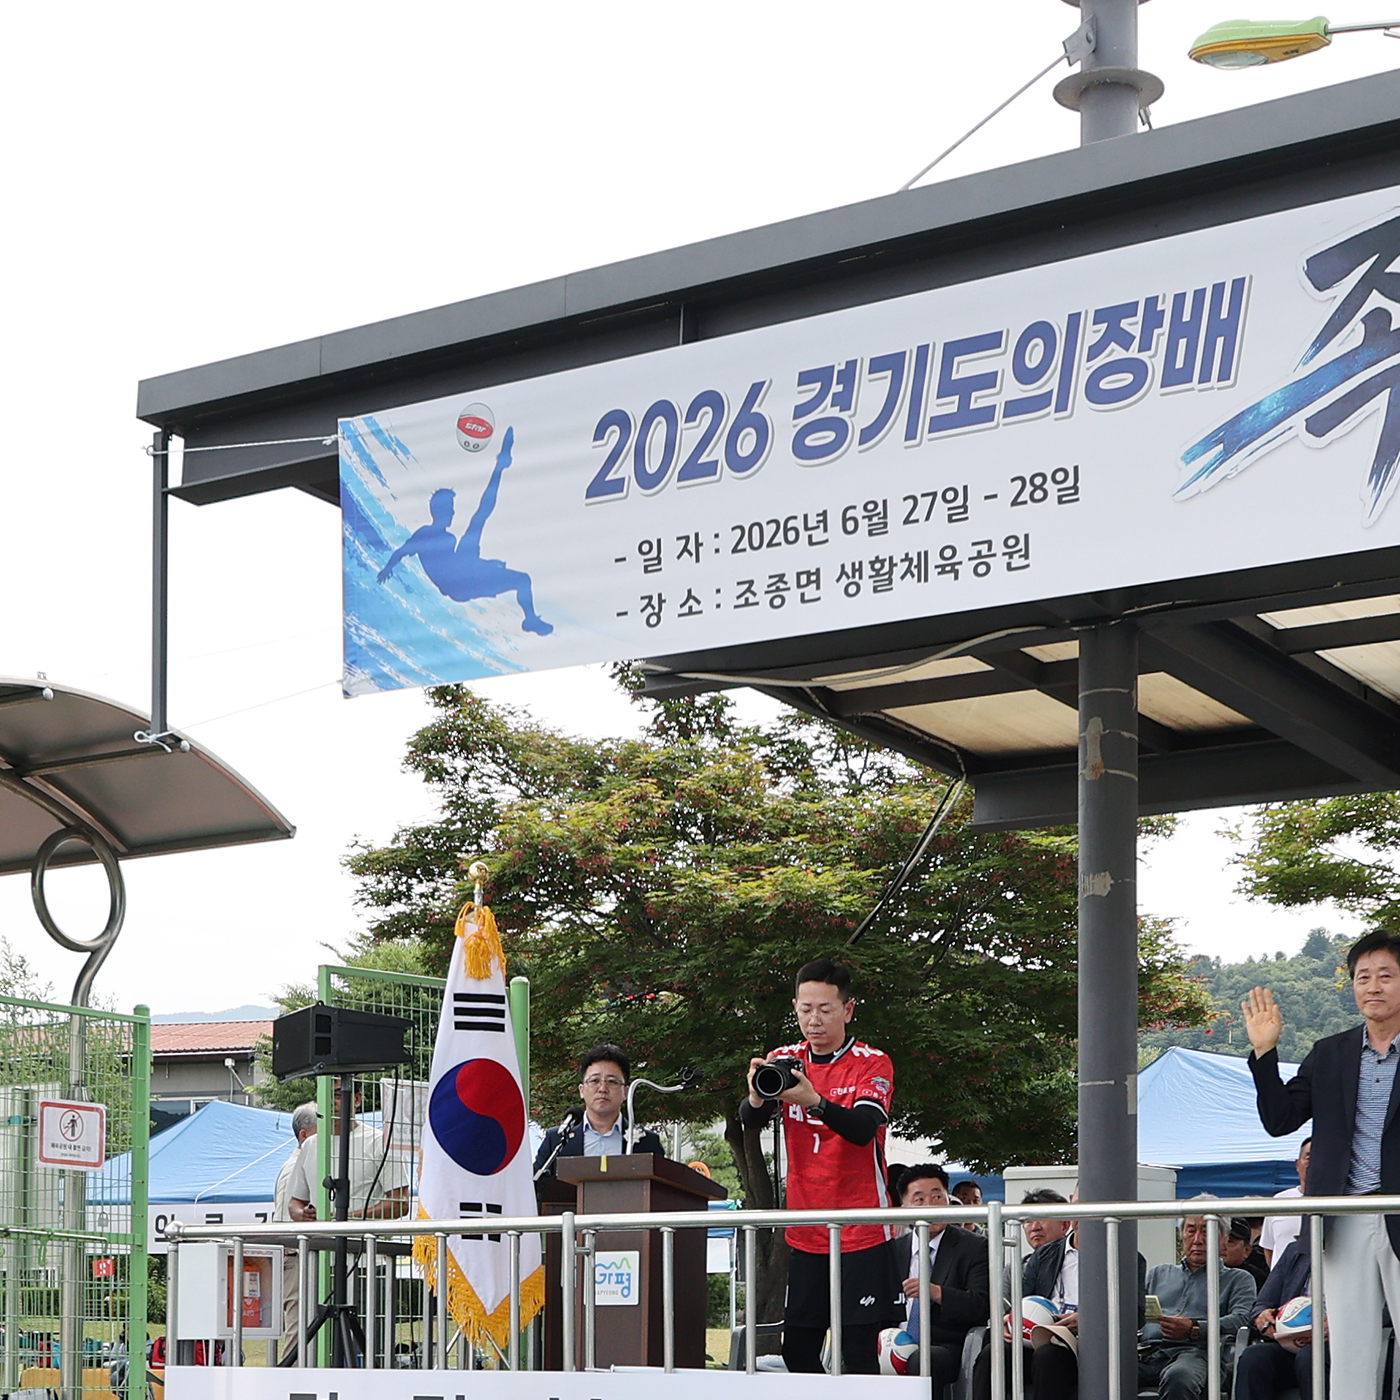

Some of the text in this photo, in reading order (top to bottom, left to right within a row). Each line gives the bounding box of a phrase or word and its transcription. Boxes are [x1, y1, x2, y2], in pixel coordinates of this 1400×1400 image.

[585, 379, 774, 502] 2026
[791, 275, 1250, 466] 경기도의장배
[730, 507, 831, 557] 2026년
[840, 497, 890, 538] 6월
[902, 483, 971, 526] 27일
[1009, 465, 1081, 508] 28일
[733, 566, 823, 611] 조종면
[835, 532, 1032, 599] 생활체육공원
[813, 1132, 821, 1154] 1
